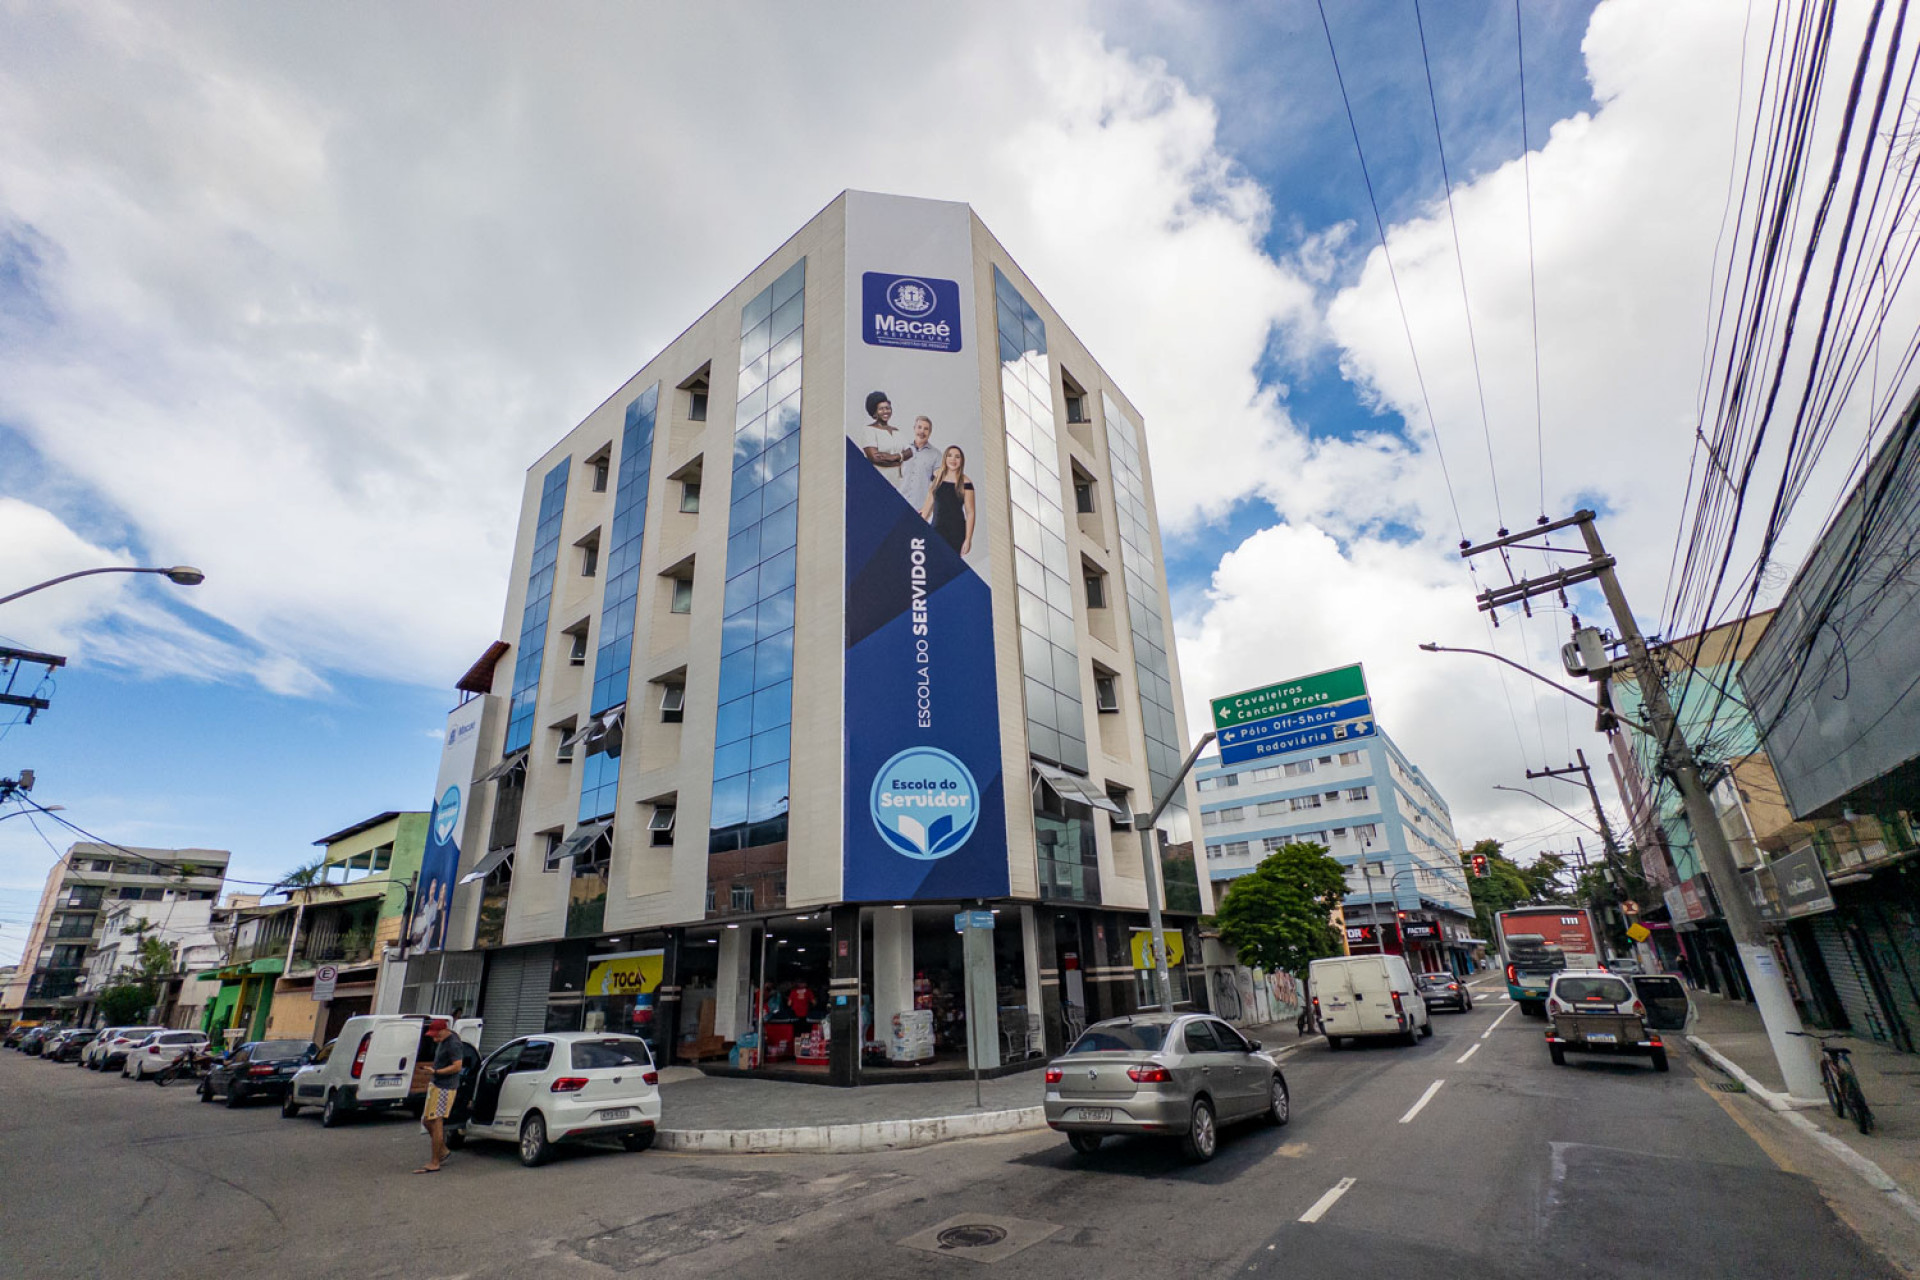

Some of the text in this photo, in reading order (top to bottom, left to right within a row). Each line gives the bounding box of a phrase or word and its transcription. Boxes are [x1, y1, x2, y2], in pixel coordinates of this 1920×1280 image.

[875, 314, 950, 336] Macaé
[876, 330, 950, 342] PREFEITURA
[910, 538, 931, 728] ESCOLA DO SERVIDOR
[1235, 686, 1302, 706] Cavaleiros
[1237, 692, 1329, 719] Cancela Preta
[1240, 710, 1337, 738] Pólo Off-Shore
[1256, 732, 1327, 754] Rodoviária
[892, 778, 957, 790] Escola do
[881, 790, 969, 807] Servidor
[1346, 926, 1371, 938] ORX
[321, 969, 331, 979] E
[613, 971, 644, 988] TOCA
